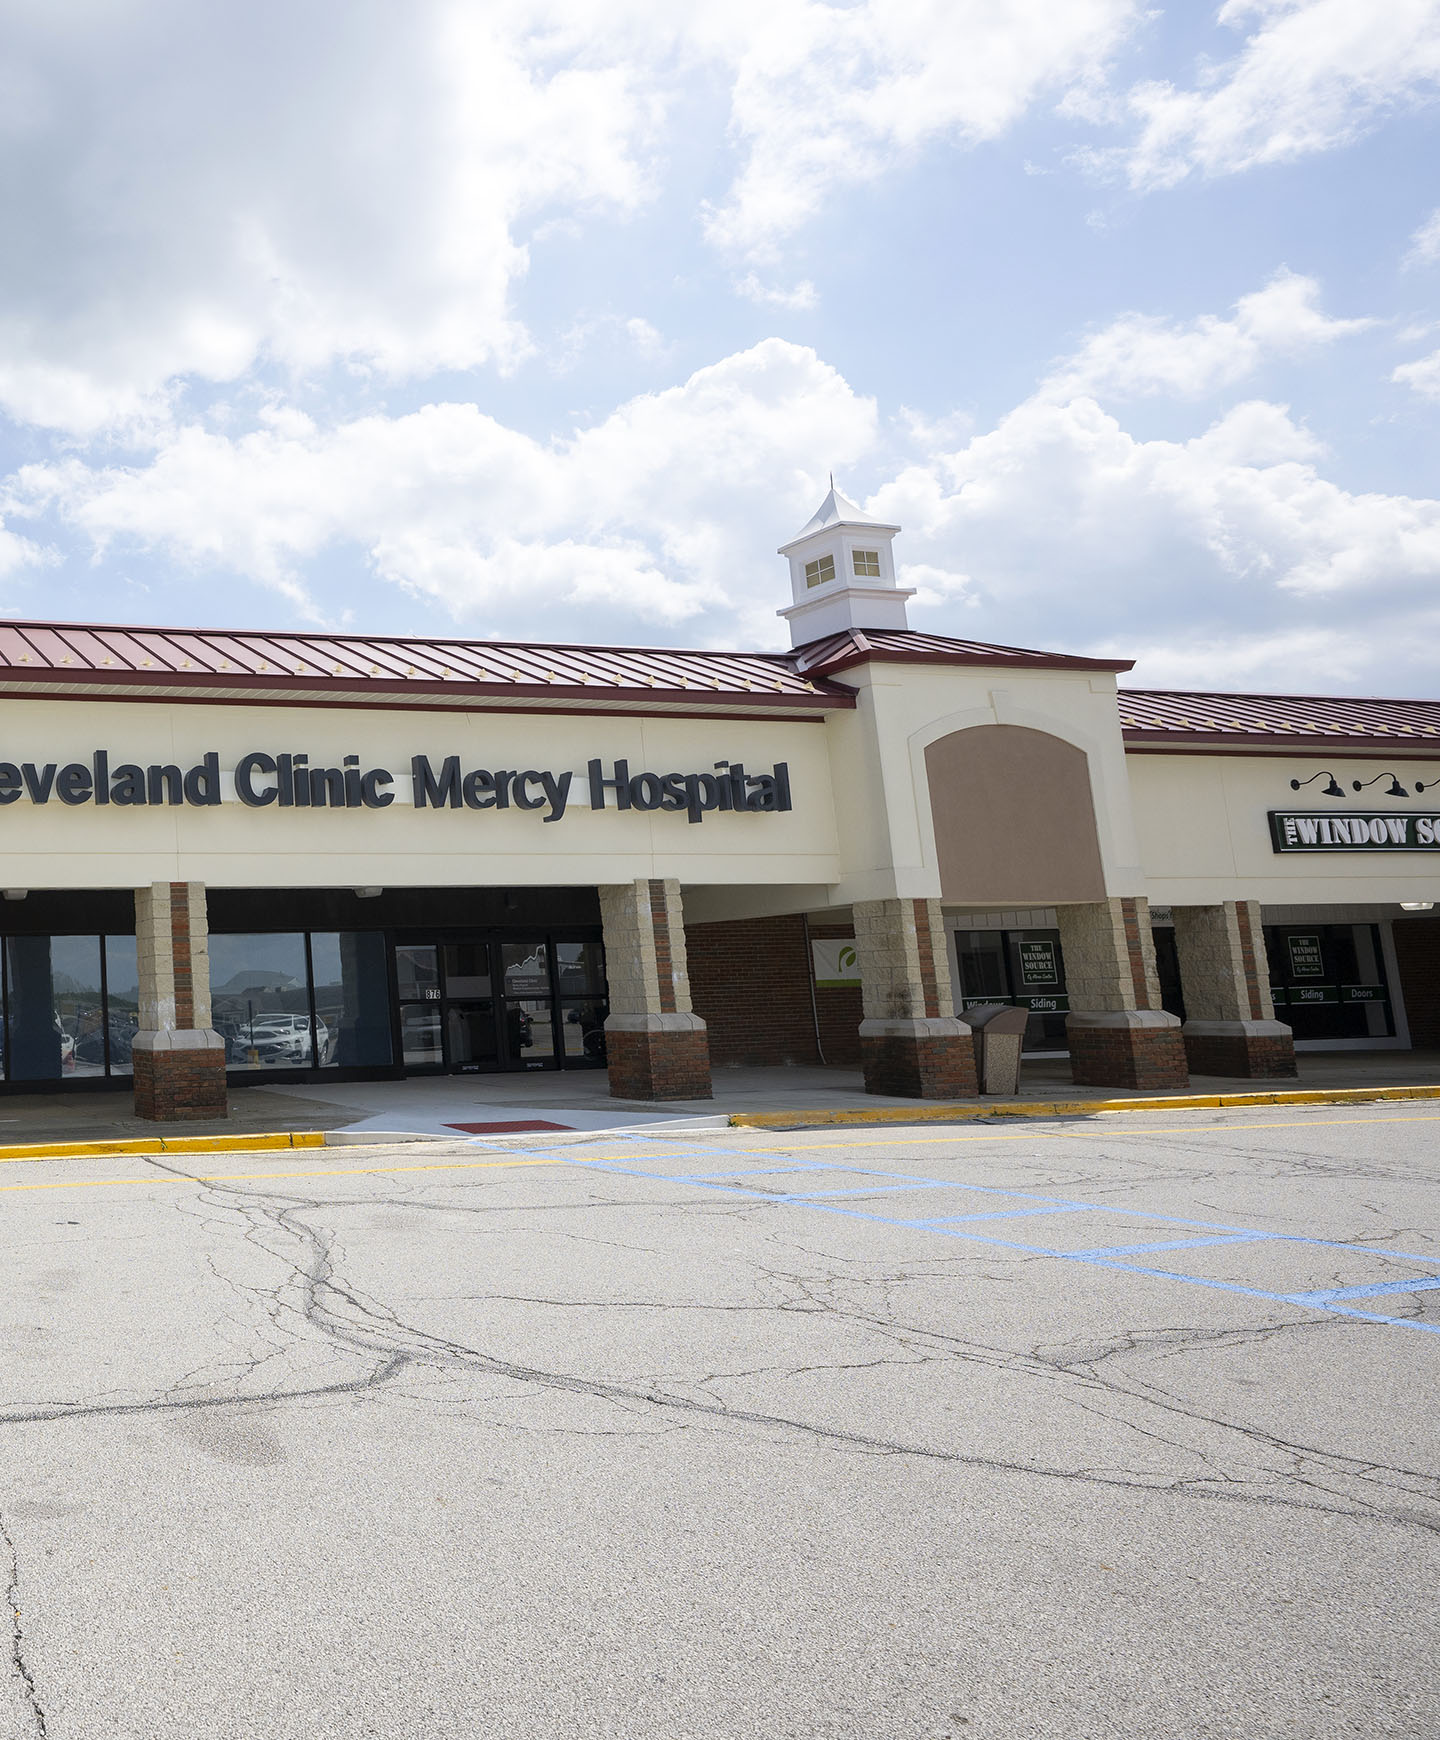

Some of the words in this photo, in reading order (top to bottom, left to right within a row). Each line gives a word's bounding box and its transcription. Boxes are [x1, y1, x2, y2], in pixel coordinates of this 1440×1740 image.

[235, 752, 395, 809] Clinic
[411, 755, 572, 823] Mercy
[587, 758, 793, 824] Hospital
[1283, 817, 1298, 846] THE
[1295, 817, 1408, 845] WINDOW
[1292, 946, 1318, 954] WINDOW
[1022, 952, 1052, 961] WINDOW
[1294, 954, 1320, 963] SOURCE
[1025, 961, 1053, 970] SOURCE
[426, 989, 441, 1000] 876
[1300, 989, 1324, 1000] Siding
[1351, 988, 1373, 998] Doors
[1030, 998, 1057, 1010] Siding
